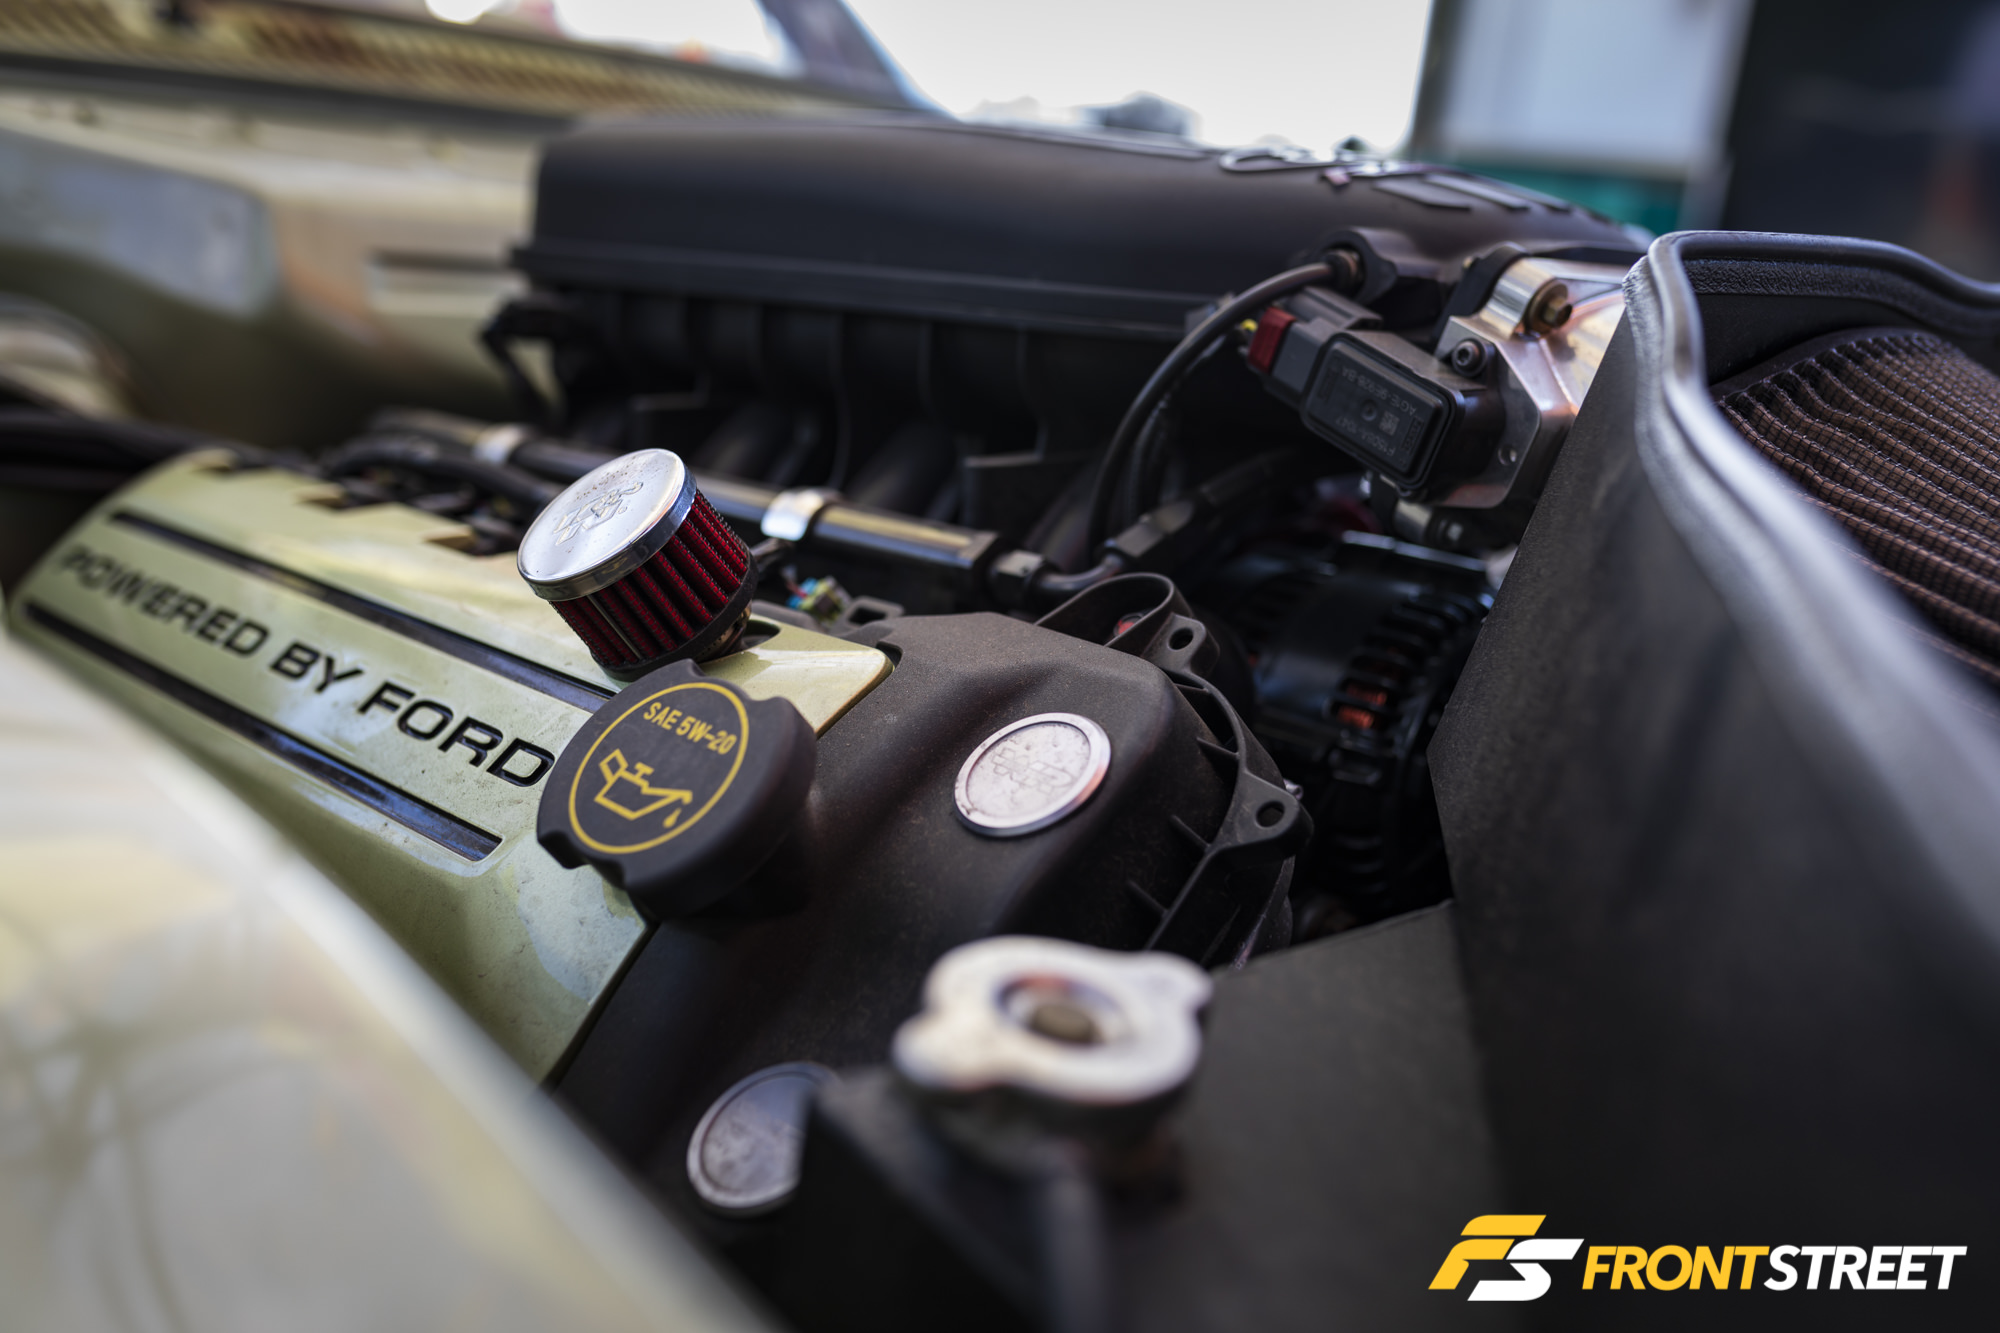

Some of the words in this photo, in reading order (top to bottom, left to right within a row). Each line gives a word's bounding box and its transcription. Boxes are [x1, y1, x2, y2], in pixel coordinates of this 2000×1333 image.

[60, 548, 269, 656] POWERED
[271, 641, 363, 693] BY
[358, 682, 555, 788] FORD
[643, 702, 678, 731] SAE
[676, 715, 737, 755] 5W-20
